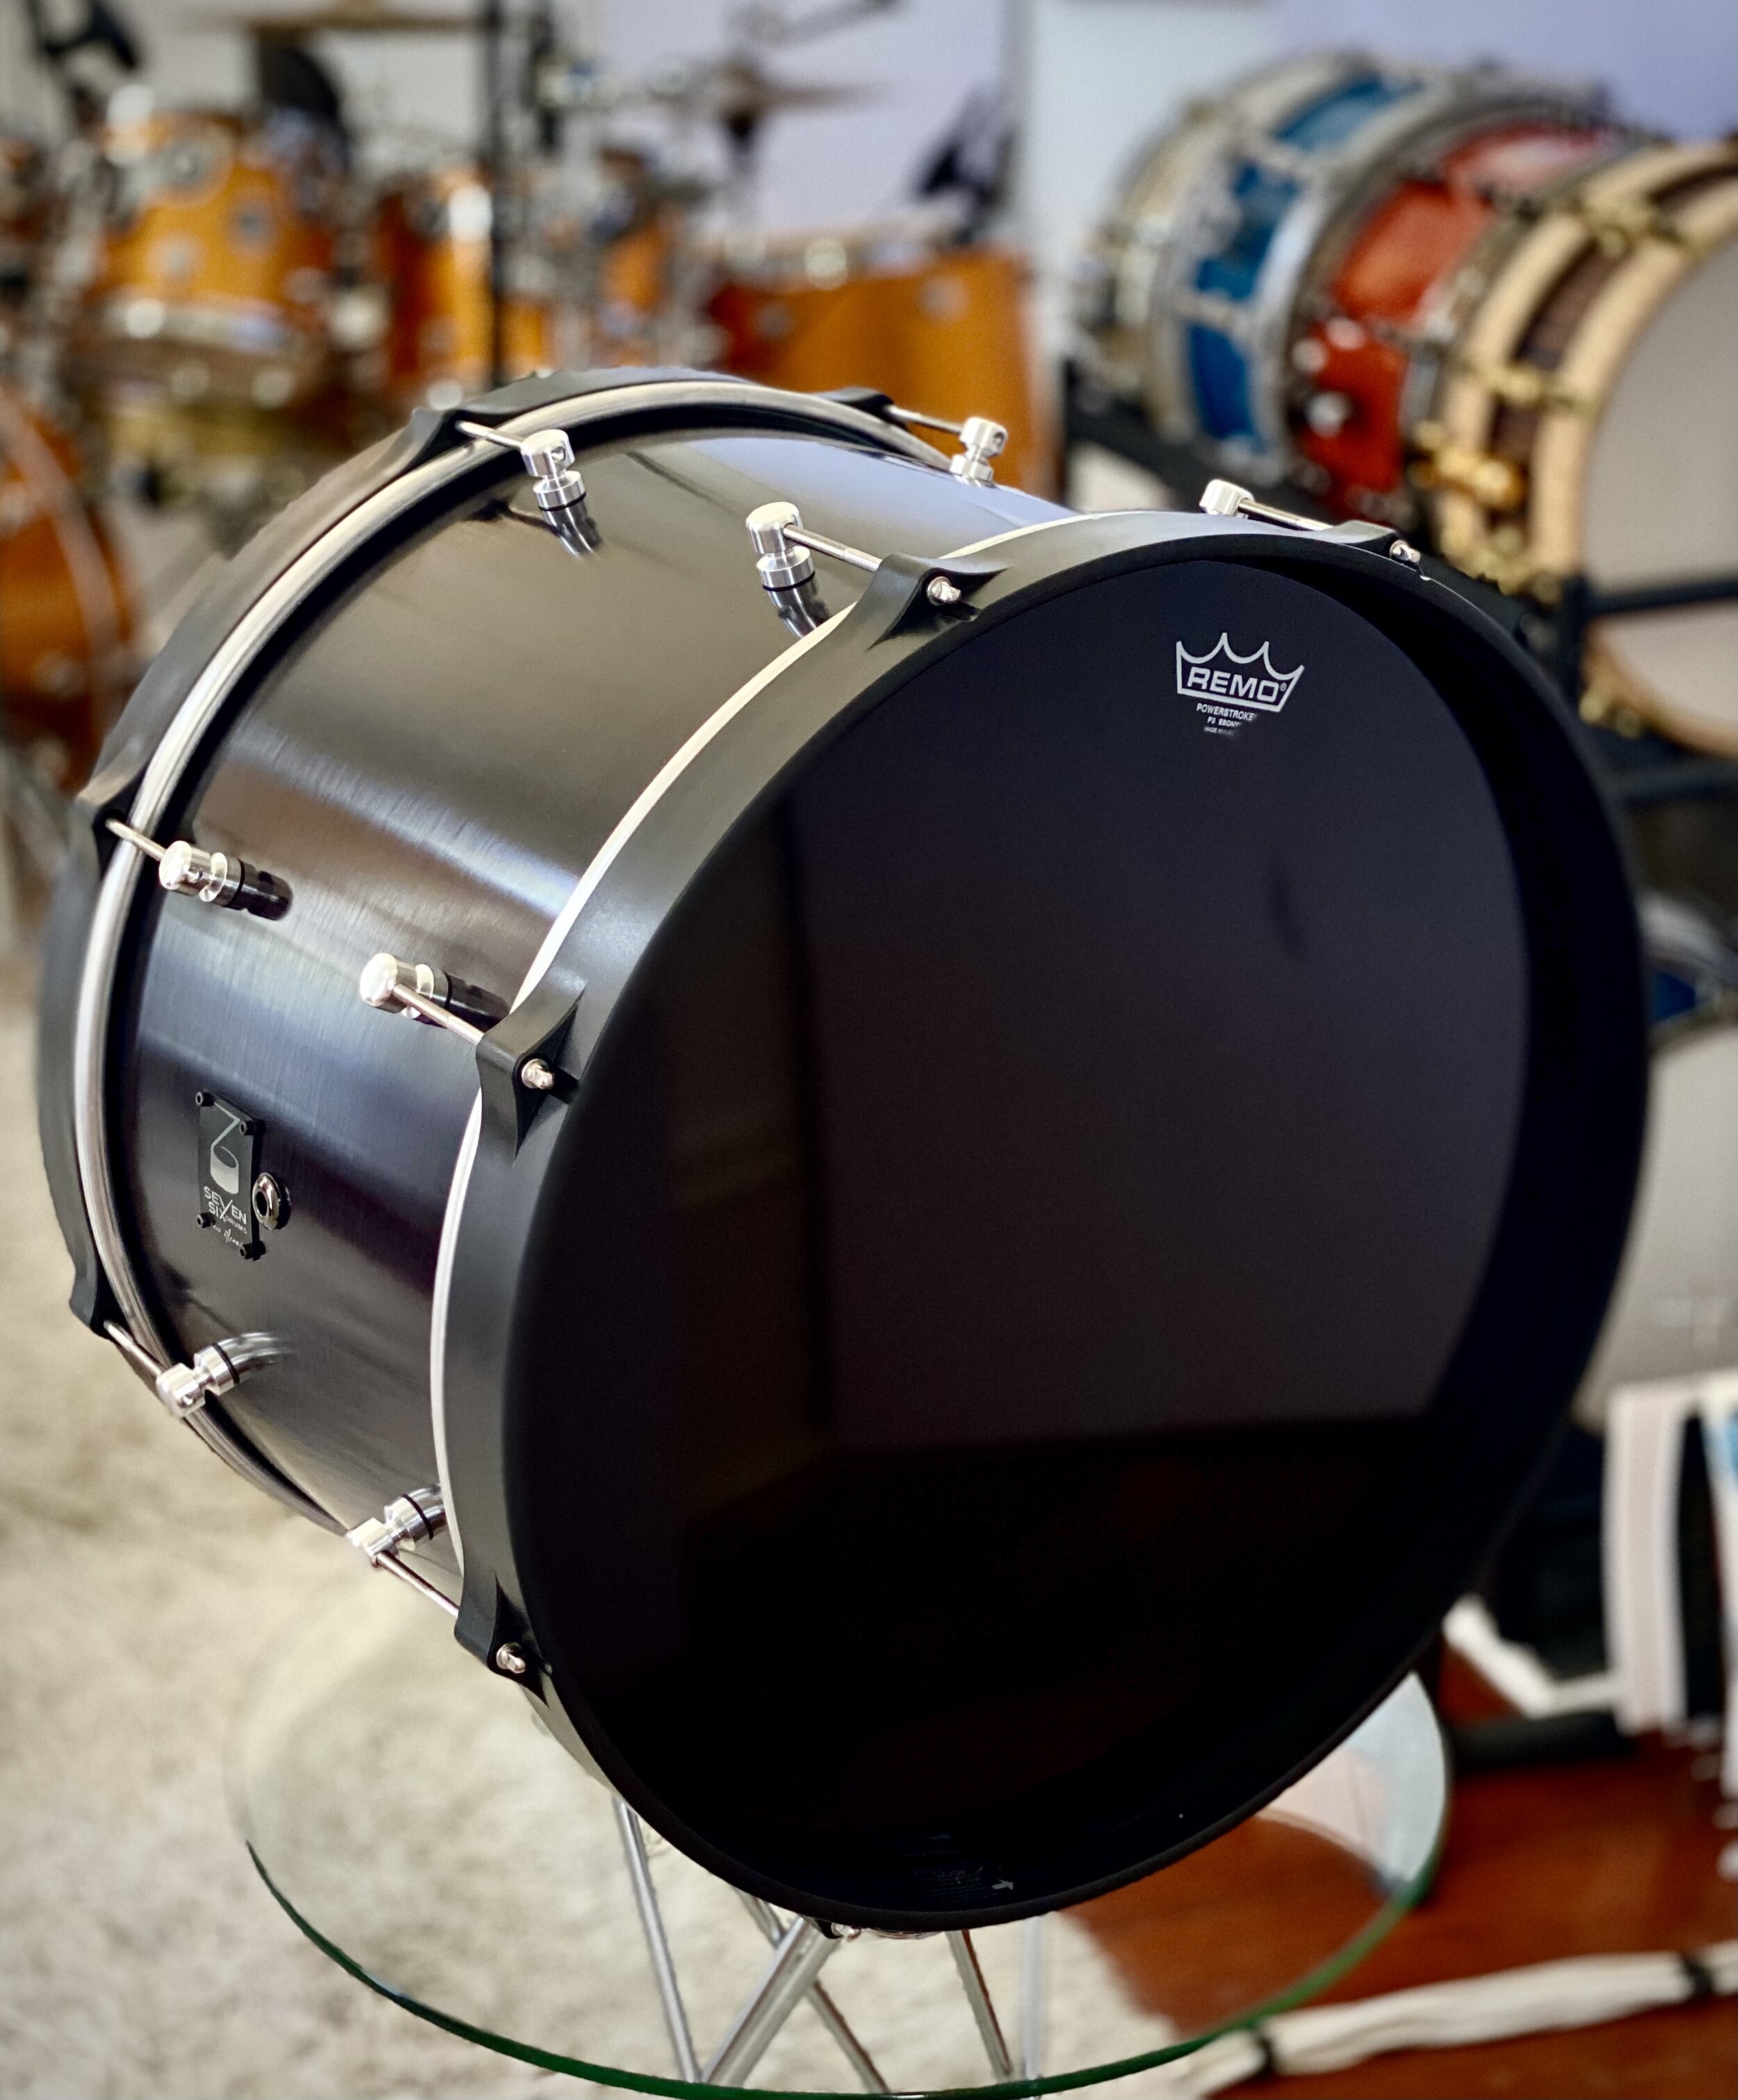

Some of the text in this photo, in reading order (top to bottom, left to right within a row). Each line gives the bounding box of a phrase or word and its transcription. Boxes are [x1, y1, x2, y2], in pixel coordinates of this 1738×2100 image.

[1196, 703, 1254, 721] POWERSTROKE
[204, 1186, 247, 1224] SEVEN
[209, 1201, 228, 1222] SIX
